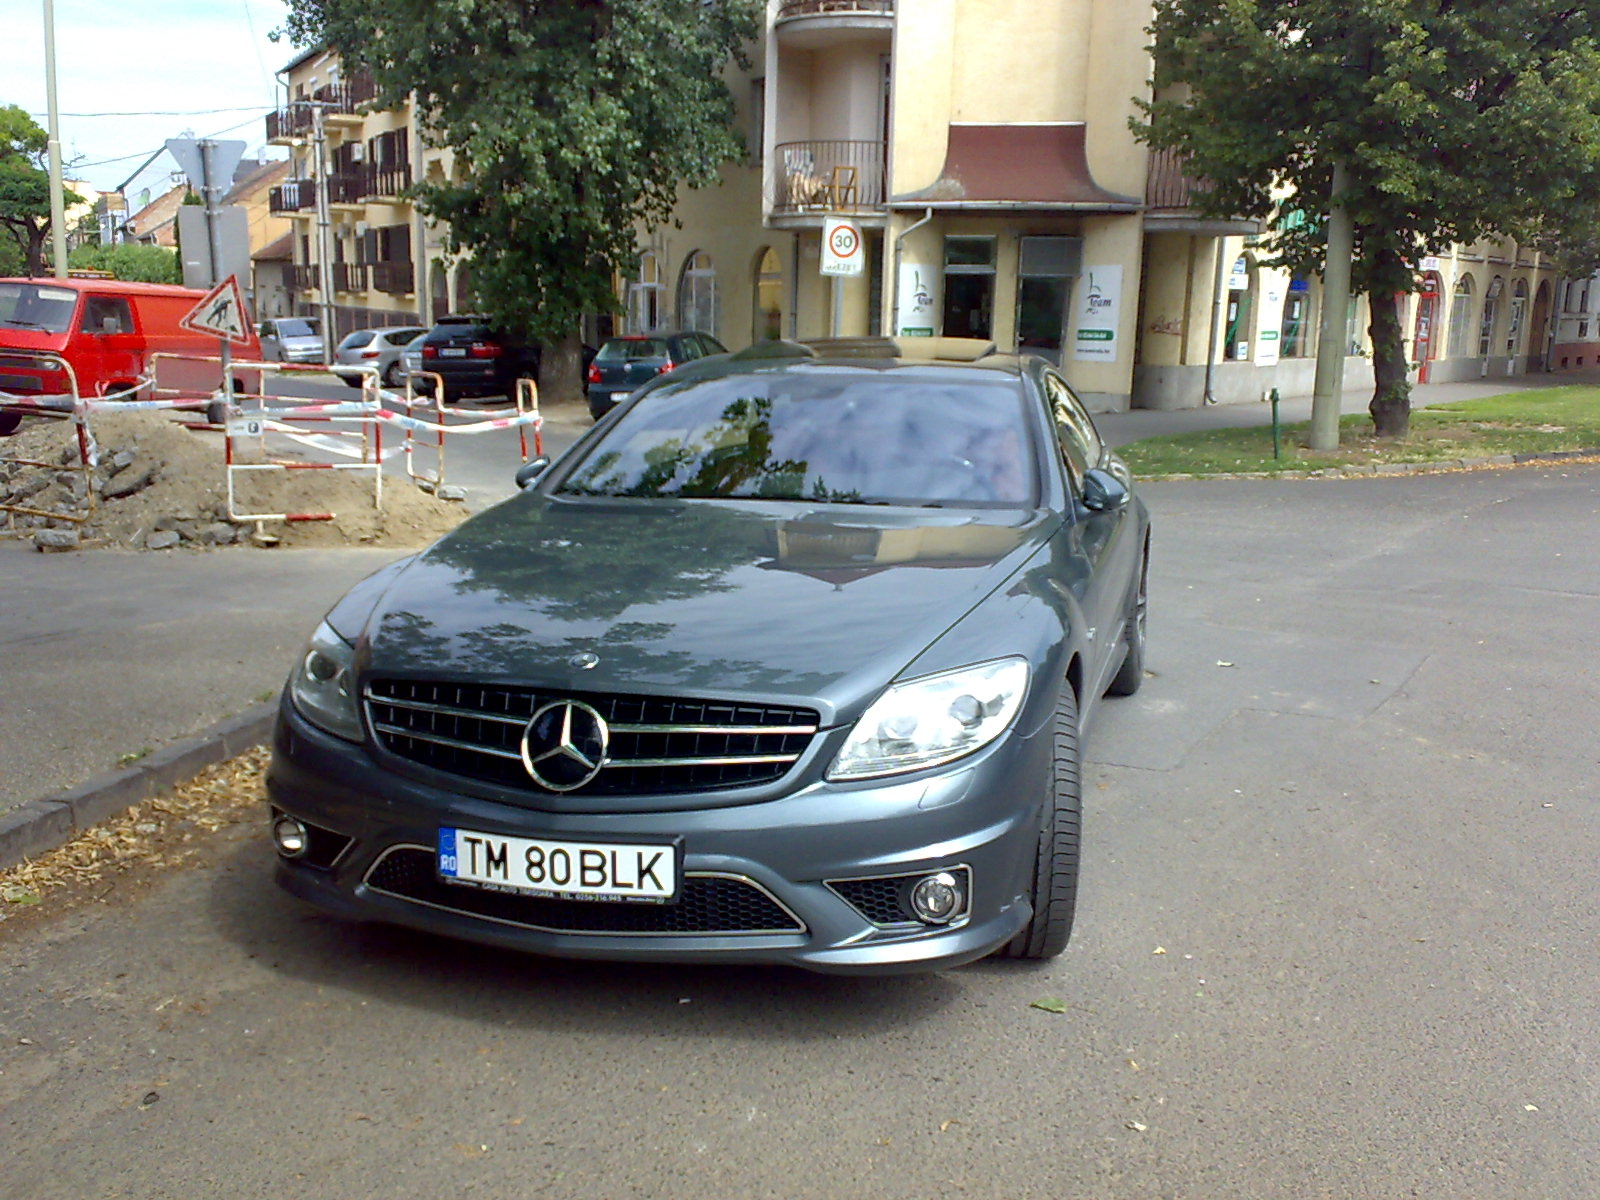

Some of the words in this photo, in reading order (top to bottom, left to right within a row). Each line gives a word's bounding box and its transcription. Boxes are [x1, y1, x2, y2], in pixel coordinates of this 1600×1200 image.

[835, 235, 853, 248] 30
[1087, 294, 1112, 307] Team
[440, 854, 456, 871] RO
[464, 837, 509, 880] TM
